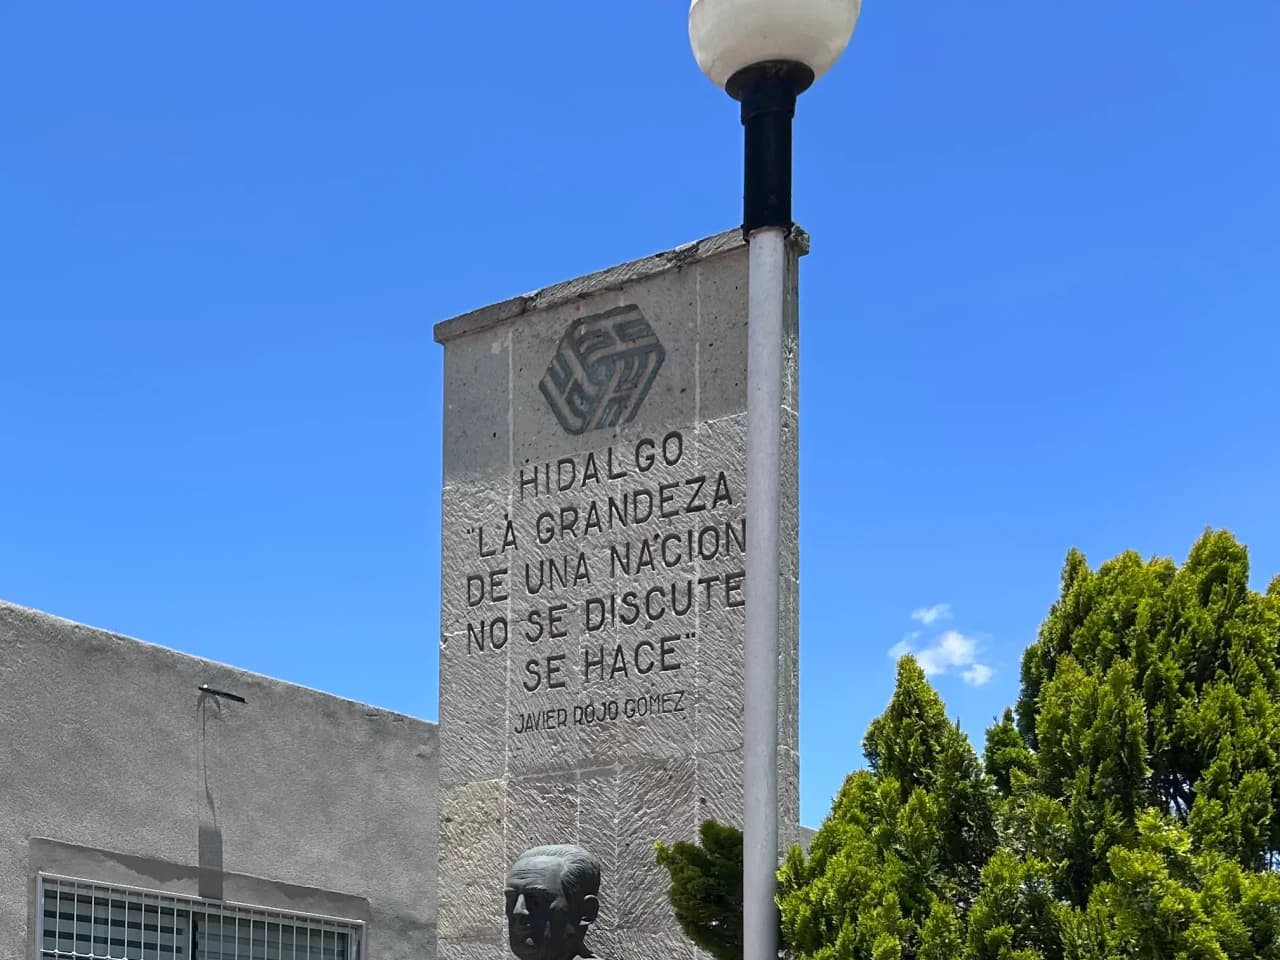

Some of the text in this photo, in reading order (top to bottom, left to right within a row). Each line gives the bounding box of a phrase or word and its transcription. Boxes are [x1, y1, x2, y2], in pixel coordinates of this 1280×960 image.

[519, 430, 684, 500] HIDALGO
[535, 470, 734, 545] GRANDEZA
[466, 518, 747, 608] DE UNA NACION
[466, 570, 746, 657] NO SE DISCUTE
[522, 653, 567, 693] SE
[514, 690, 686, 734] JAVIER ROJO GOMEZ
